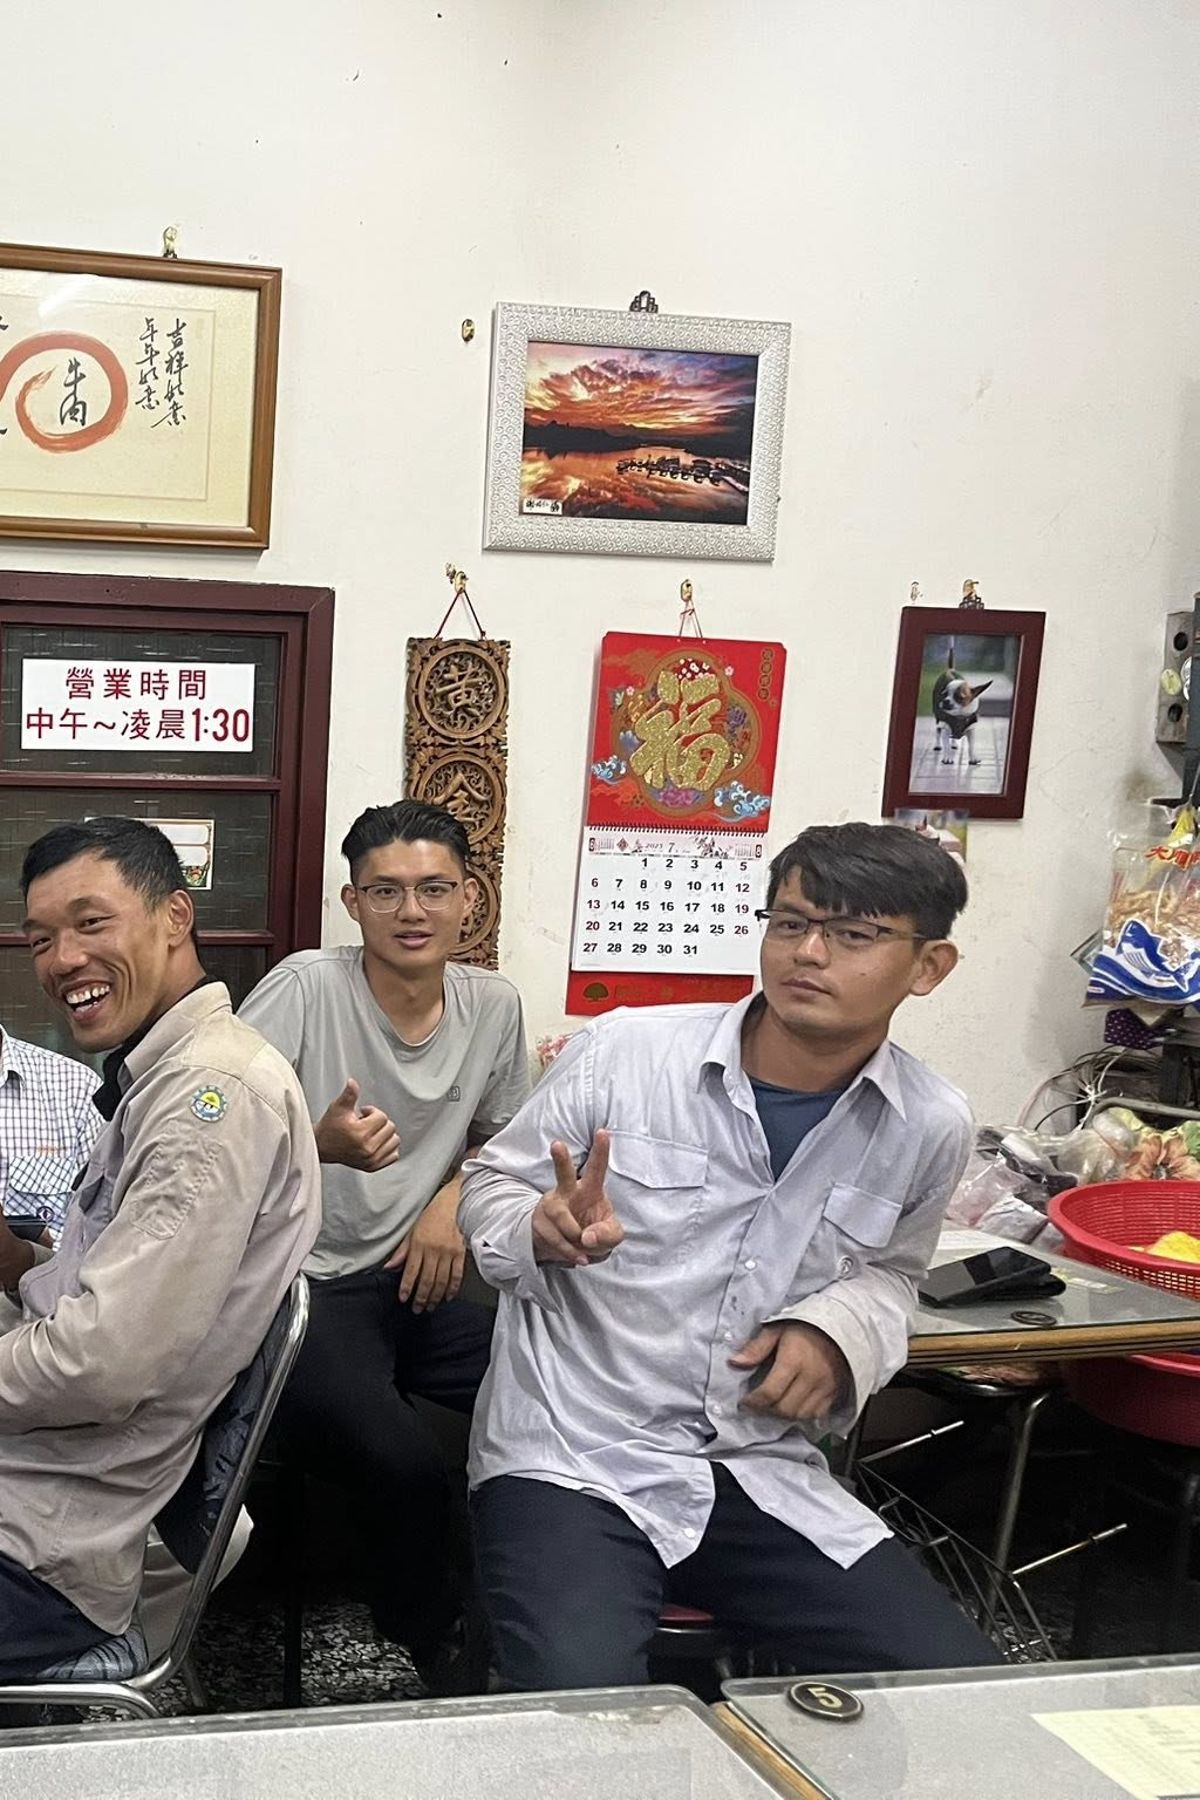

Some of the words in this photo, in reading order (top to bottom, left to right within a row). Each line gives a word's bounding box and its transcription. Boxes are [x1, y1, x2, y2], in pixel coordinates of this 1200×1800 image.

[66, 667, 206, 700] 營業時間
[668, 842, 676, 853] 7
[641, 857, 648, 868] 1
[665, 858, 674, 869] 2
[690, 859, 699, 869] 3
[714, 860, 723, 870] 4
[739, 861, 748, 872] 5
[591, 877, 599, 888] 6
[615, 878, 624, 888] 7
[639, 879, 648, 889] 8
[663, 879, 673, 890] 9
[686, 880, 702, 891] 10
[710, 882, 724, 892] 11
[735, 883, 750, 893] 12
[587, 899, 601, 910] 13
[611, 900, 625, 910] 14
[635, 900, 650, 911] 15
[659, 901, 675, 912] 16
[684, 902, 701, 913] 17
[710, 903, 725, 913] 18
[735, 904, 750, 914] 19
[585, 920, 600, 931] 20
[608, 921, 622, 931] 21
[632, 921, 649, 933] 22
[657, 922, 674, 933] 23
[683, 923, 700, 934] 24
[709, 924, 725, 935] 25
[734, 925, 749, 935] 26
[582, 942, 598, 953] 27
[606, 942, 622, 953] 28
[631, 943, 648, 954] 29
[656, 944, 673, 955] 30
[683, 944, 698, 955] 31
[808, 1687, 843, 1708] 5
